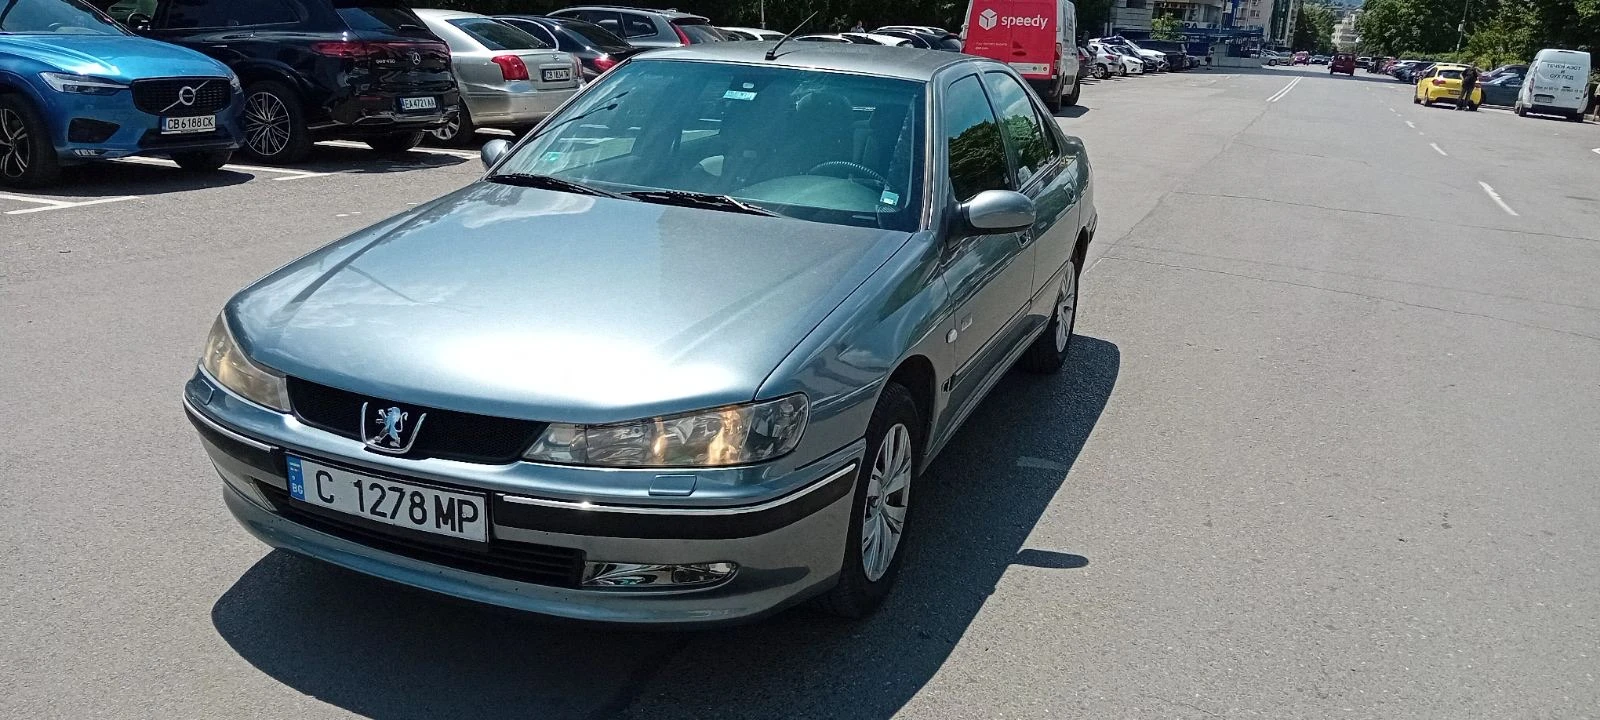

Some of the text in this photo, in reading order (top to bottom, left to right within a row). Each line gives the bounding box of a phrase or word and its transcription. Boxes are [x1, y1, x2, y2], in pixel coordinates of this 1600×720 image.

[1001, 14, 1048, 30] speedy
[292, 483, 303, 495] BG
[315, 470, 479, 533] C 1278 MP
